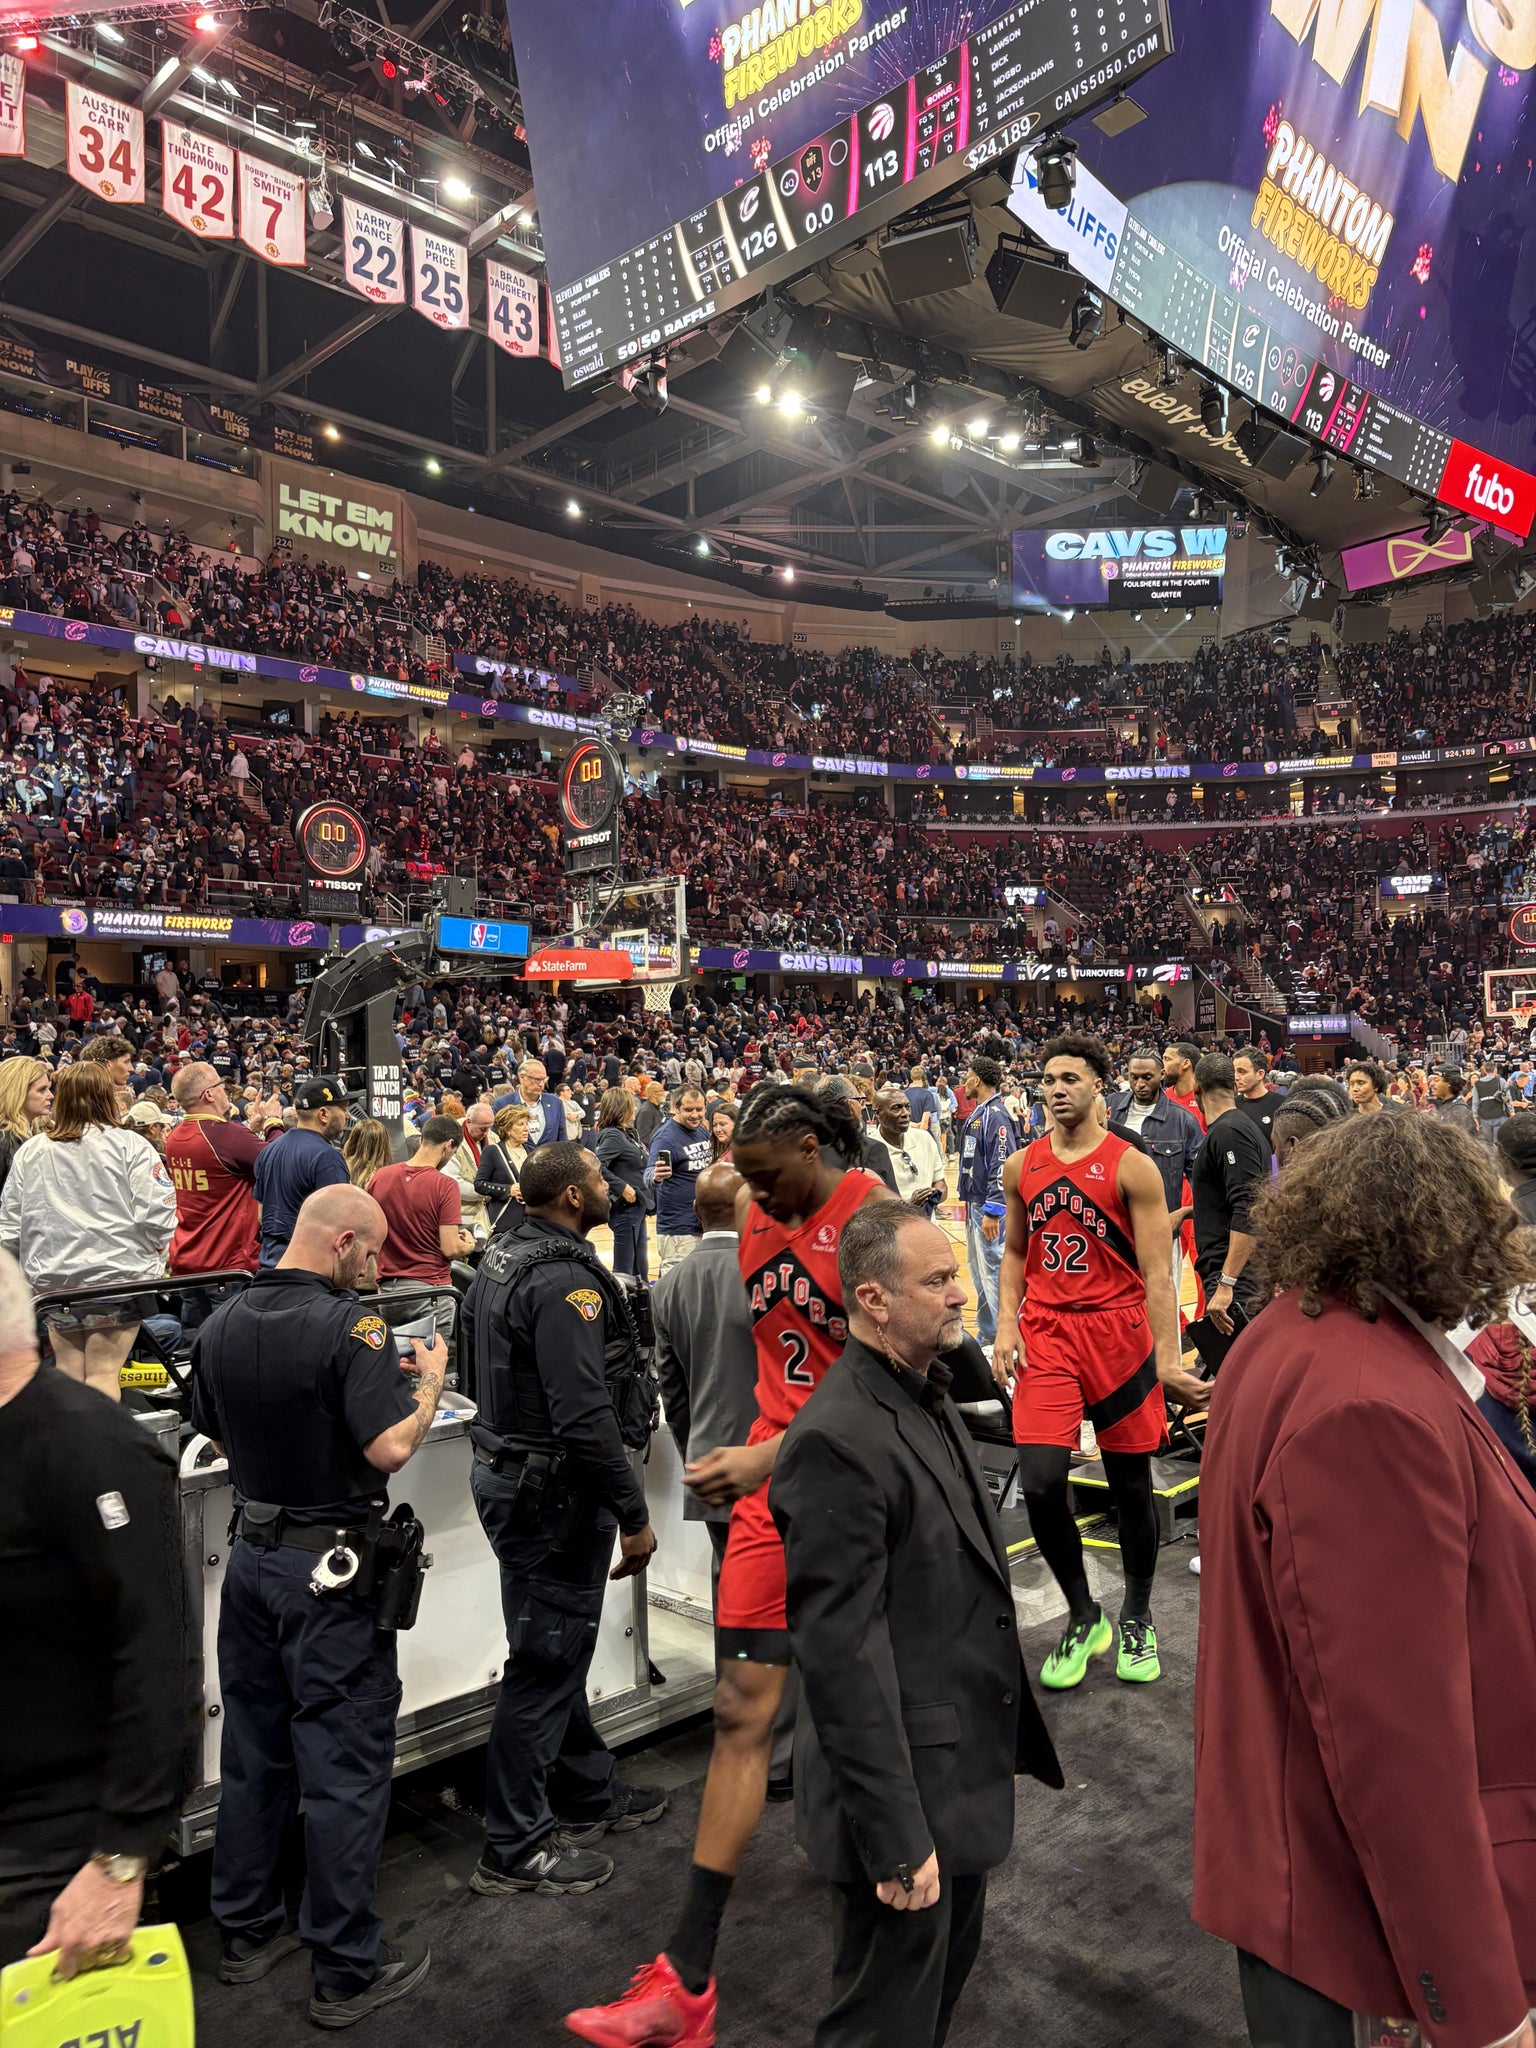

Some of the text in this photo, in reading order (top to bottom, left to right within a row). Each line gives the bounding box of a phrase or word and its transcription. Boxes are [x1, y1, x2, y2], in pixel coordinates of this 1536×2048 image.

[722, 0, 827, 70] PHANT
[976, 13, 1015, 45] TORONTO
[988, 28, 1021, 56] LAWSON
[724, 0, 863, 109] FIREWORKS
[991, 54, 1009, 72] DICK
[926, 57, 948, 76] FOULS
[993, 63, 1022, 88] MOGBO
[1054, 33, 1159, 112] CAVS5050.COM
[704, 7, 909, 153] Official Celebration Partner
[975, 59, 1055, 117] 32 JACKSON-DAVIS
[927, 84, 953, 106] BONUS
[81, 95, 131, 123] AUSTIN
[945, 111, 956, 123] 48
[978, 96, 1025, 132] 77 BATTLE
[88, 111, 125, 134] CARR
[923, 126, 933, 138] 52
[182, 134, 215, 158] NATE
[943, 132, 953, 143] CH
[967, 116, 1031, 171] $24,189
[78, 125, 137, 186] 34
[168, 142, 229, 176] THURMOND
[918, 148, 931, 159] TOL
[244, 163, 269, 179] BOBBY
[864, 150, 899, 188] 113
[172, 164, 225, 222] 42
[253, 176, 291, 201] SMITH
[1267, 120, 1393, 267] PHANTOM
[261, 196, 283, 241] 7
[356, 208, 392, 231] LARRY
[690, 208, 708, 224] FOULS
[805, 202, 834, 234] 0.0
[355, 220, 393, 244] NANCE
[663, 232, 673, 242] FLS
[741, 222, 778, 262] 126
[1251, 176, 1378, 309] FIREWORKS
[425, 238, 455, 258] MARK
[715, 250, 724, 260] 50
[352, 235, 398, 290] 22
[425, 249, 456, 270] PRICE
[420, 263, 463, 314] 25
[489, 276, 537, 304] DAUGHERTY
[499, 270, 526, 288] BRAD
[1218, 225, 1391, 370] Official Celebration Partner
[494, 294, 533, 343] 43
[572, 309, 587, 321] ELLIS
[561, 318, 593, 340] 20 TYSON
[573, 352, 604, 379] oswald
[663, 301, 716, 337] RAFFLE
[562, 331, 595, 352] 22 NANCE
[564, 342, 598, 364] 35 TOMLIN
[65, 359, 93, 378] PLAY
[1234, 361, 1255, 391] 126
[82, 375, 111, 396] OFFS
[138, 383, 161, 398] LET
[138, 400, 185, 423] KNOW.
[1121, 377, 1202, 425] Arena
[1271, 391, 1287, 412] 0.0
[210, 404, 236, 423] PLAY
[1305, 408, 1323, 433] 113
[225, 420, 250, 438] OFFS
[274, 443, 314, 462] KNOW.
[1354, 448, 1361, 456] 77
[1464, 463, 1515, 515] fubo
[279, 483, 394, 532] LET EM
[276, 537, 293, 549] 224
[279, 508, 397, 559] KNOW.
[1045, 528, 1228, 561] CAVS W
[1121, 559, 1224, 572] PHANTOM FIREWORKS
[1123, 580, 1162, 588] FOULSHERE
[1169, 579, 1183, 587] THE
[1183, 578, 1210, 587] FOURTH
[1151, 590, 1182, 599] QUARTER
[1427, 614, 1442, 622] 230
[134, 635, 257, 672] CAVS WIN
[368, 678, 408, 694] PHANTOM
[408, 685, 449, 702] FIREWORKS
[527, 709, 576, 731] CAVS
[688, 740, 717, 751] PHANTOM
[1401, 741, 1526, 761] oswald $24,189 +13
[581, 759, 602, 782] 0.0
[812, 757, 888, 776] CAVS WIN
[968, 766, 1001, 777] PHANTOM
[1001, 767, 1035, 777] FIREWORKS
[1104, 765, 1191, 780] CAVS WIN
[1279, 758, 1315, 768] PHANTOM
[1314, 755, 1354, 766] FIREWORKS
[321, 823, 346, 842] 0.0
[579, 831, 612, 846] TISSOT
[324, 879, 363, 891] TISSOT
[1390, 875, 1433, 886] CAVS
[52, 897, 86, 908] Huntington
[150, 903, 182, 913] Huntington
[93, 911, 234, 931] PHANTOM FIREWORKS
[98, 926, 229, 939] Official Celebration Partner Cavaliers
[779, 954, 863, 973] CAVS WIN
[938, 963, 969, 973] PHANTOM
[969, 963, 1004, 974] FIREWORKS
[1055, 967, 1068, 978] 15
[1075, 967, 1125, 978] TURNOVERS
[1135, 967, 1148, 978] 17
[1289, 1019, 1323, 1030] CAVS
[372, 1065, 400, 1080] TAP TO
[372, 1080, 400, 1096] WATCH
[381, 1097, 401, 1120] App
[824, 1244, 837, 1253] Life
[1041, 1231, 1089, 1273] 32
[751, 1263, 848, 1341] APTORS
[778, 1329, 815, 1386] 2
[120, 1372, 170, 1383] fitness
